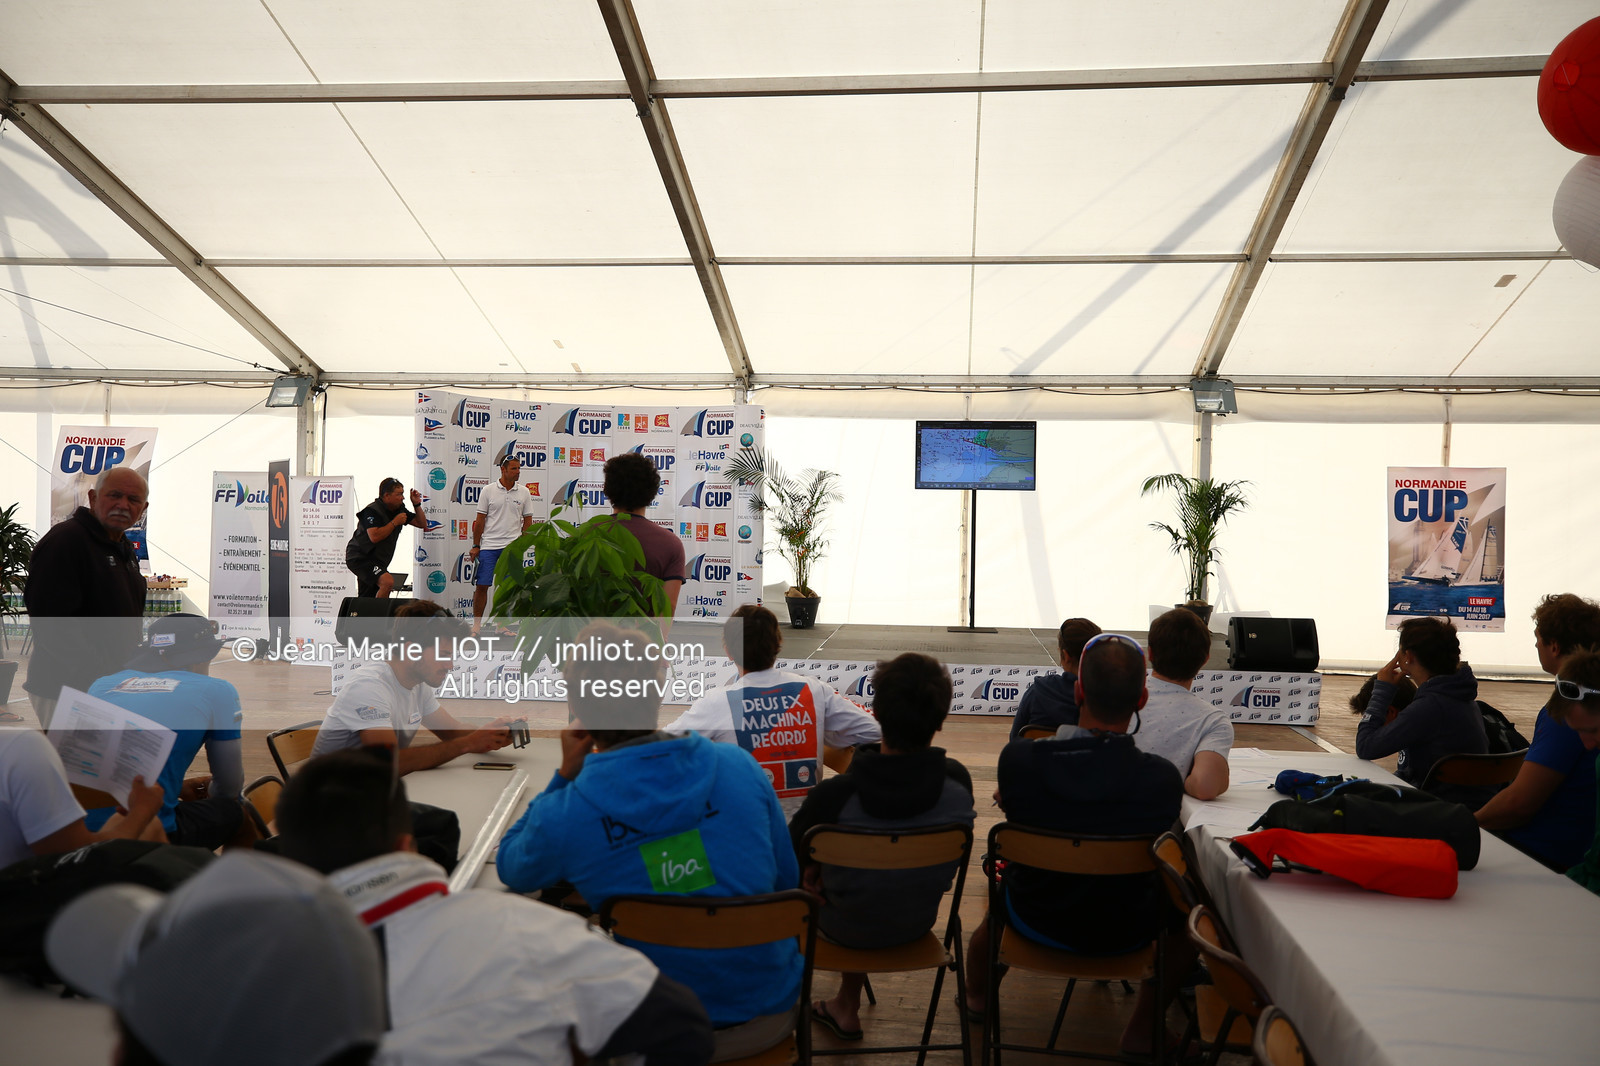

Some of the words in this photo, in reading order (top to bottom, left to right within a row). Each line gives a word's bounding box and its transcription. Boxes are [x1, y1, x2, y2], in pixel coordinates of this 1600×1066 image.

[466, 411, 490, 428] CUP
[500, 408, 536, 420] leHavre
[579, 419, 611, 434] CUP
[707, 420, 734, 435] CUP
[65, 436, 126, 446] NORMANDIE
[60, 444, 125, 475] CUP
[516, 452, 546, 467] CUP
[689, 450, 725, 460] leHavre
[1395, 480, 1466, 489] NORMANDIE
[320, 490, 342, 503] CUP
[465, 487, 482, 503] CU
[705, 492, 732, 507] CUP
[1394, 489, 1468, 522] CUP
[224, 548, 261, 557] ENTRAÎNEMENT
[223, 562, 260, 571] ÉVÉNEMENTIEL
[705, 565, 731, 580] CUP
[686, 595, 722, 606] leHavre
[993, 688, 1018, 700] CUP
[1253, 695, 1280, 707] CUP
[742, 697, 778, 713] DEUS
[783, 694, 804, 709] EX
[742, 711, 813, 731] MACHINA
[751, 729, 807, 748] RECORDS
[662, 851, 704, 886] iba
